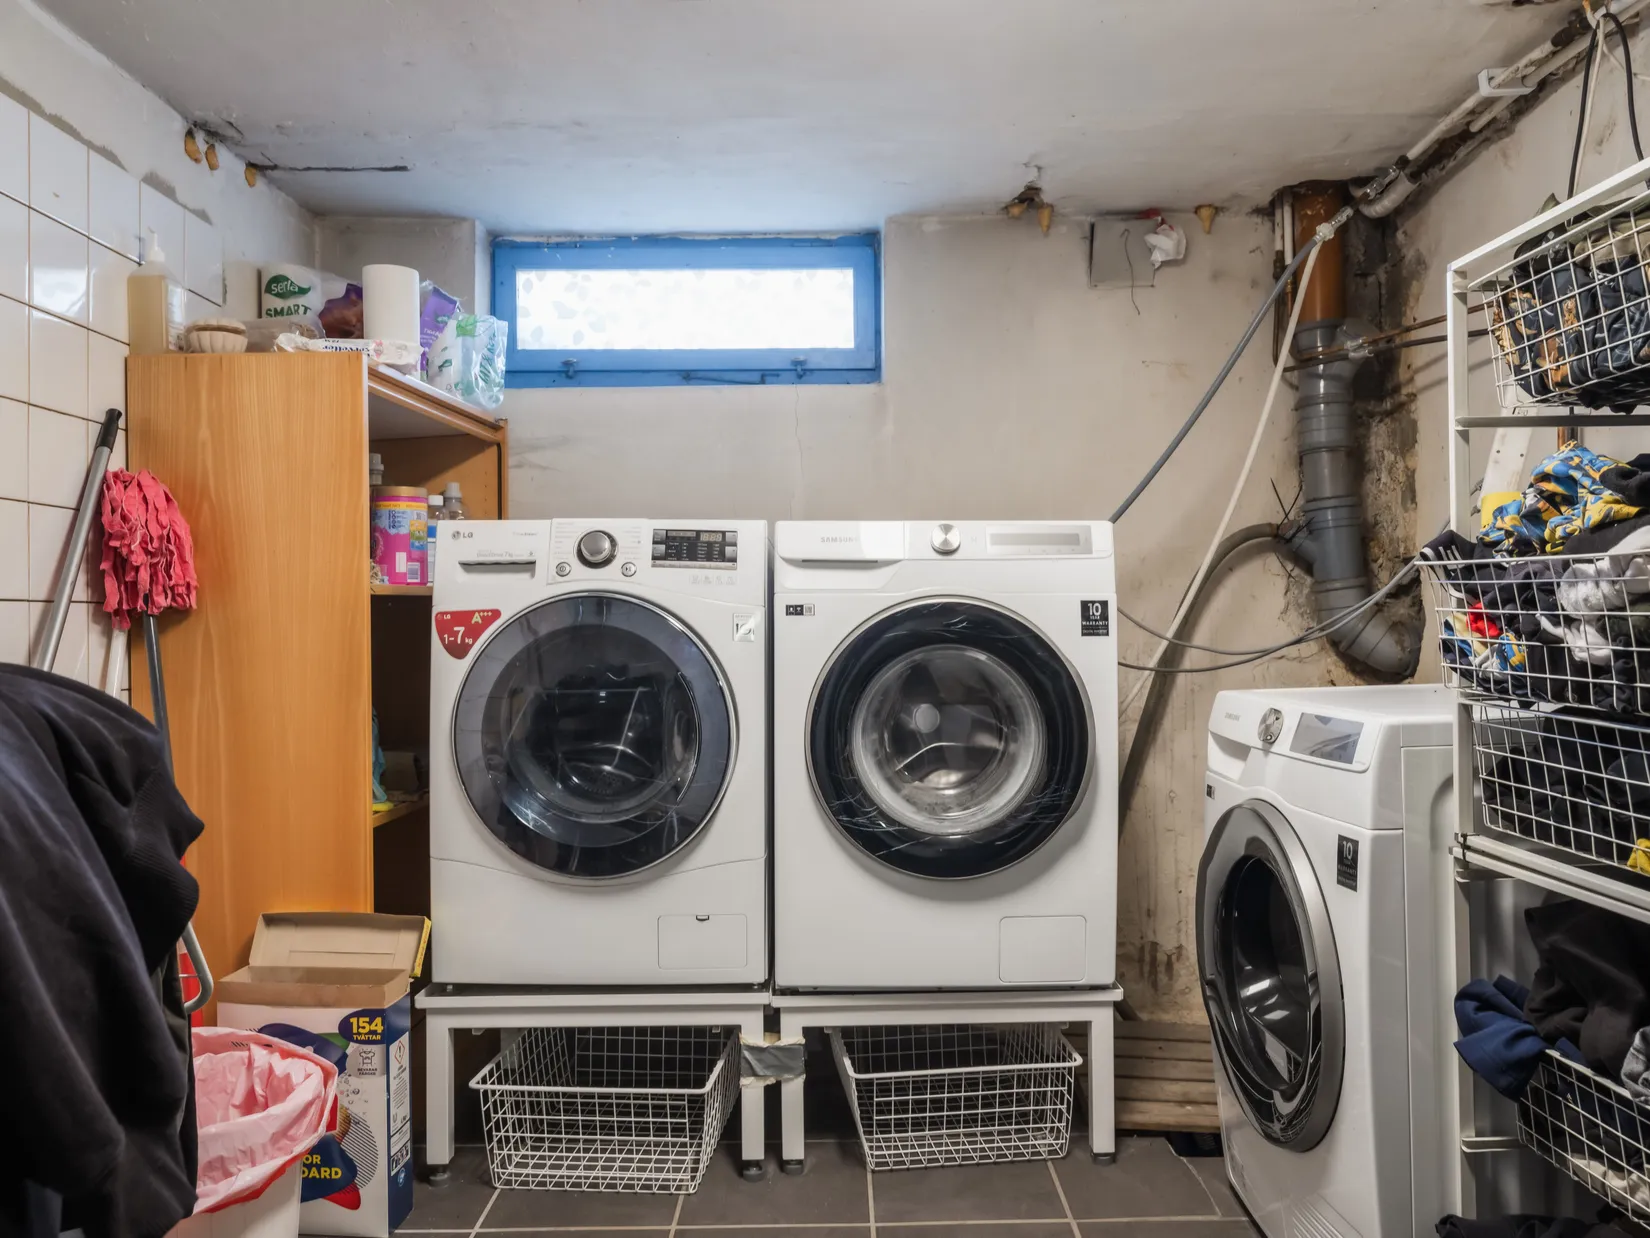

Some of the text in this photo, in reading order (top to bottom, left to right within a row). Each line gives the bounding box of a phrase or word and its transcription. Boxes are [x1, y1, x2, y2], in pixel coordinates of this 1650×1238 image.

[271, 279, 299, 294] serla
[265, 304, 312, 319] SMART
[462, 531, 473, 539] LG
[1087, 602, 1102, 616] 10
[471, 611, 493, 625] A+++
[465, 636, 473, 645] kg
[1342, 840, 1353, 859] 10
[349, 1016, 384, 1034] 154
